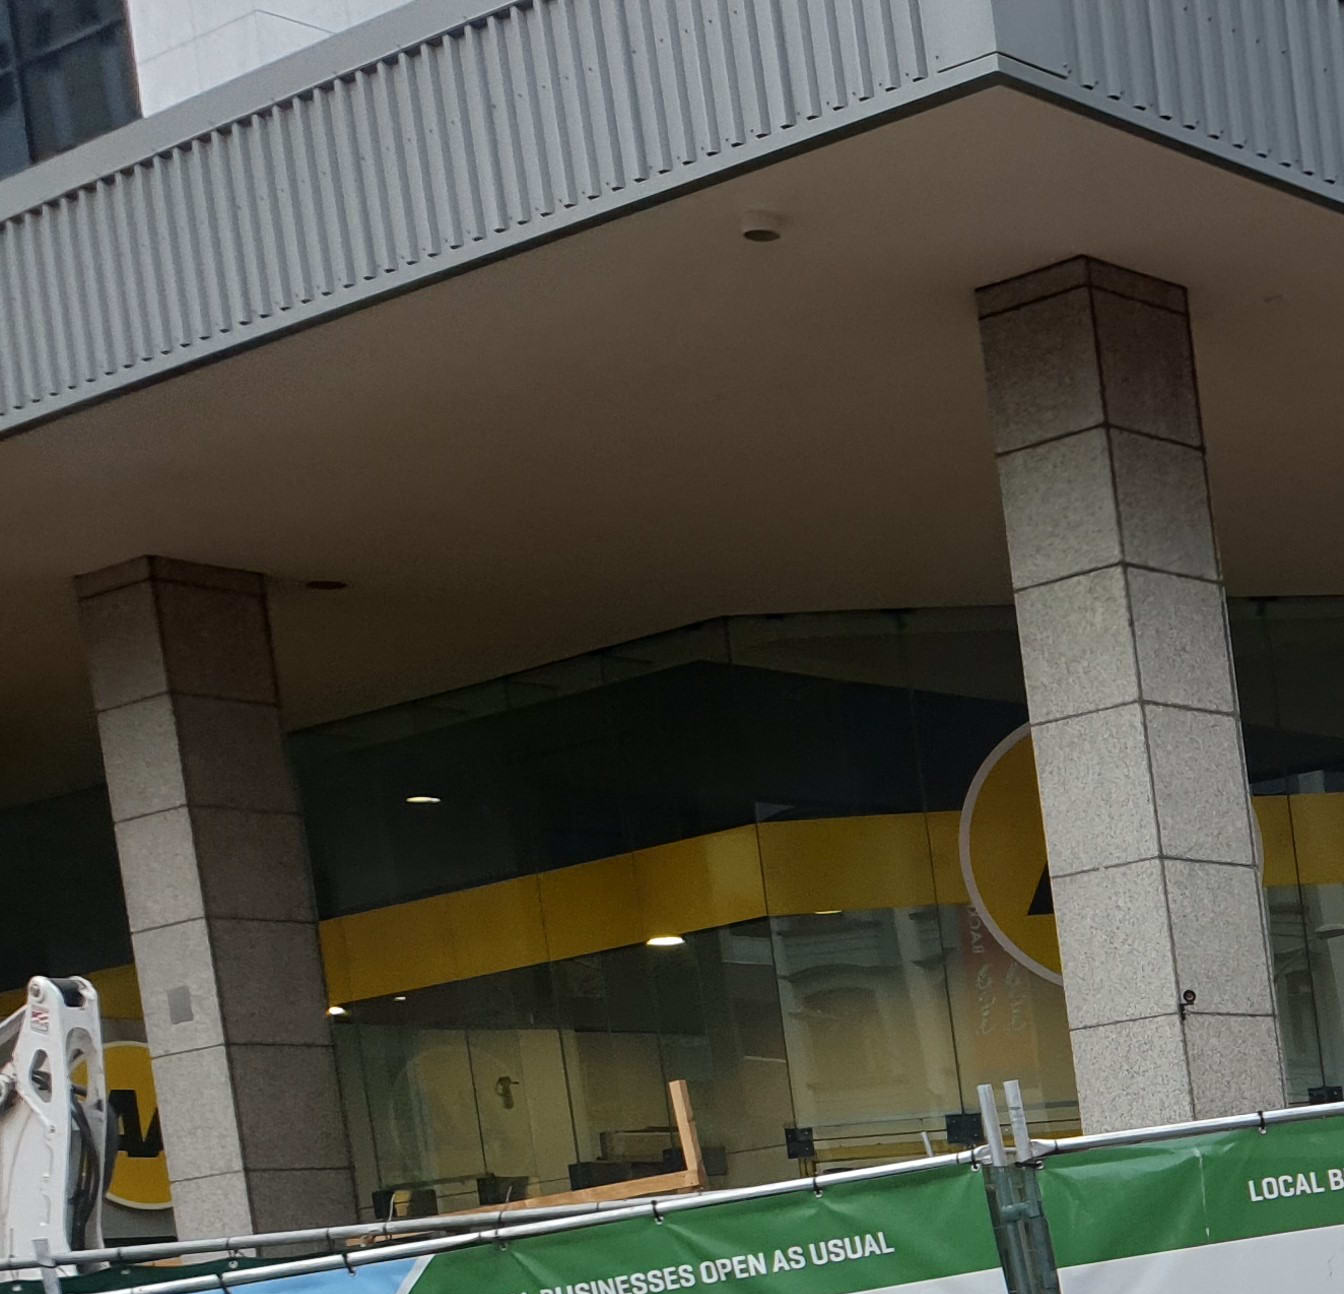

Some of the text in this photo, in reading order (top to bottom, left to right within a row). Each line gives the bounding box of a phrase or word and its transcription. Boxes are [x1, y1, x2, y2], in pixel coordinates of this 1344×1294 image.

[1247, 1170, 1325, 1203] LOCAL
[699, 1250, 765, 1284] OPEN
[771, 1246, 807, 1272] AS
[809, 1231, 895, 1267] USUAL
